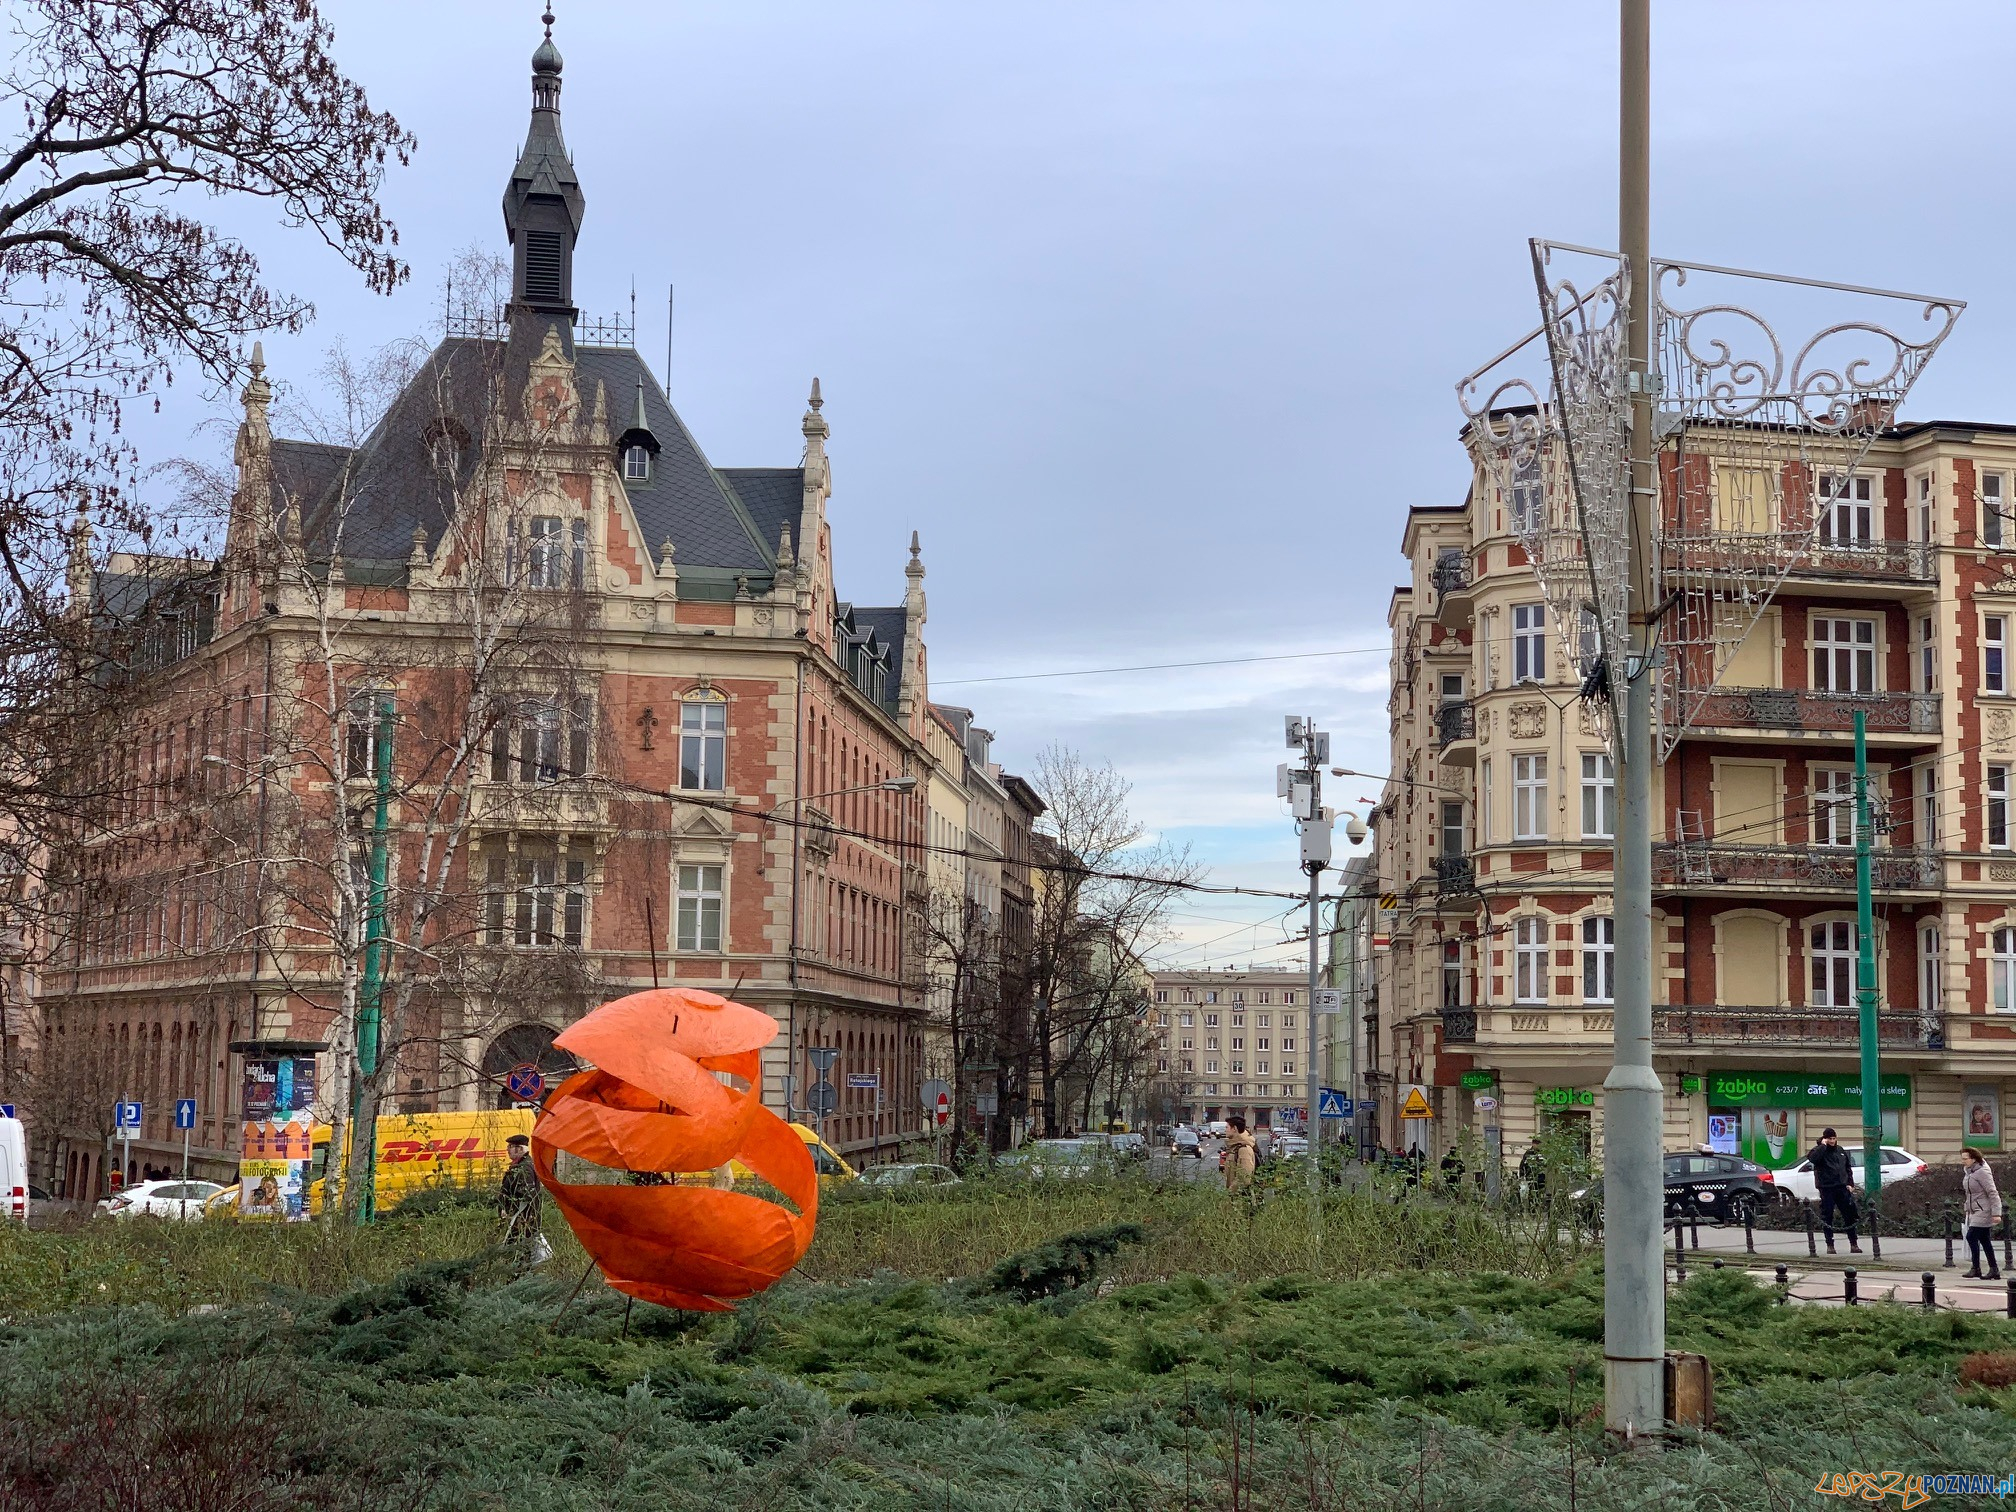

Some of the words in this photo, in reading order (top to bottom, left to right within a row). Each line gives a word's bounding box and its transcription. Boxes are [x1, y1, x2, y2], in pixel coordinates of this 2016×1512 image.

[1462, 1075, 1492, 1083] żabka
[1716, 1079, 1767, 1094] żabka
[1775, 1086, 1799, 1094] 6-23/7
[1887, 1086, 1907, 1096] sklep
[381, 1137, 486, 1163] DHL
